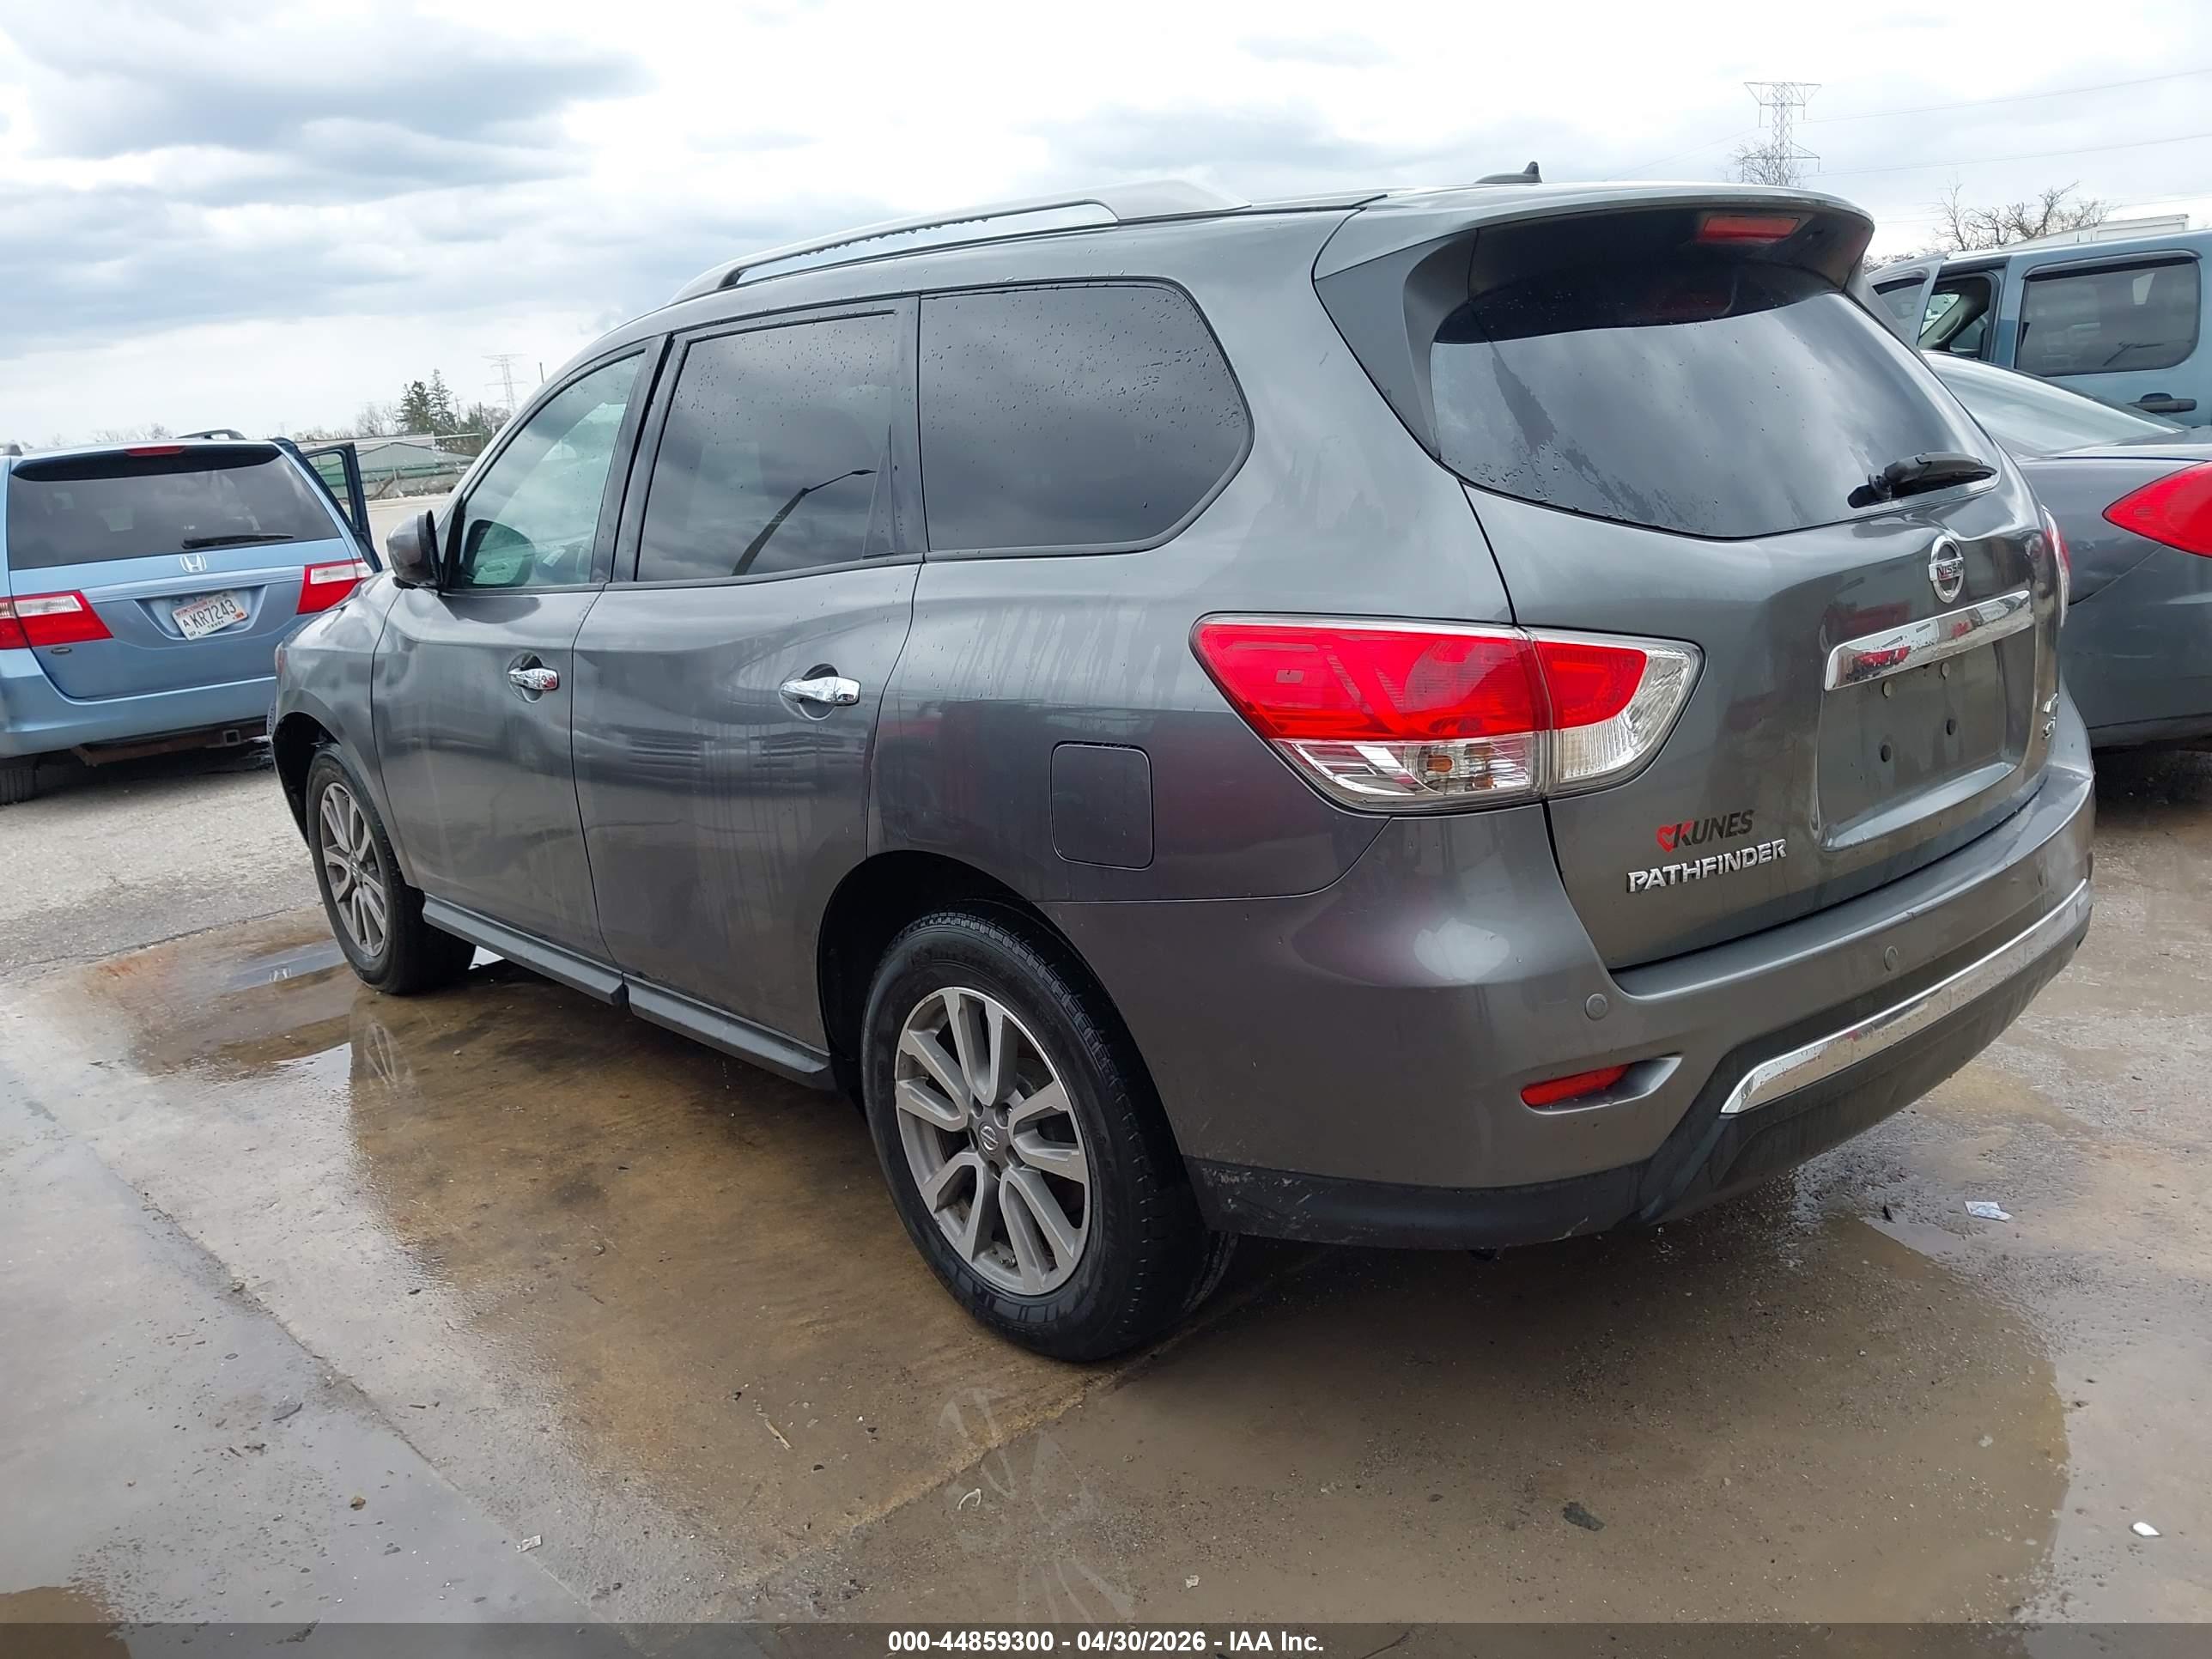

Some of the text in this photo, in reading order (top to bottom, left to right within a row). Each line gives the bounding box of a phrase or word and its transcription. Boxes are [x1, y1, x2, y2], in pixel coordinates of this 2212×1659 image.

[189, 599, 237, 629] KR7243
[1673, 809, 1754, 848] KUNES
[1627, 838, 1787, 893] PATHFINDER
